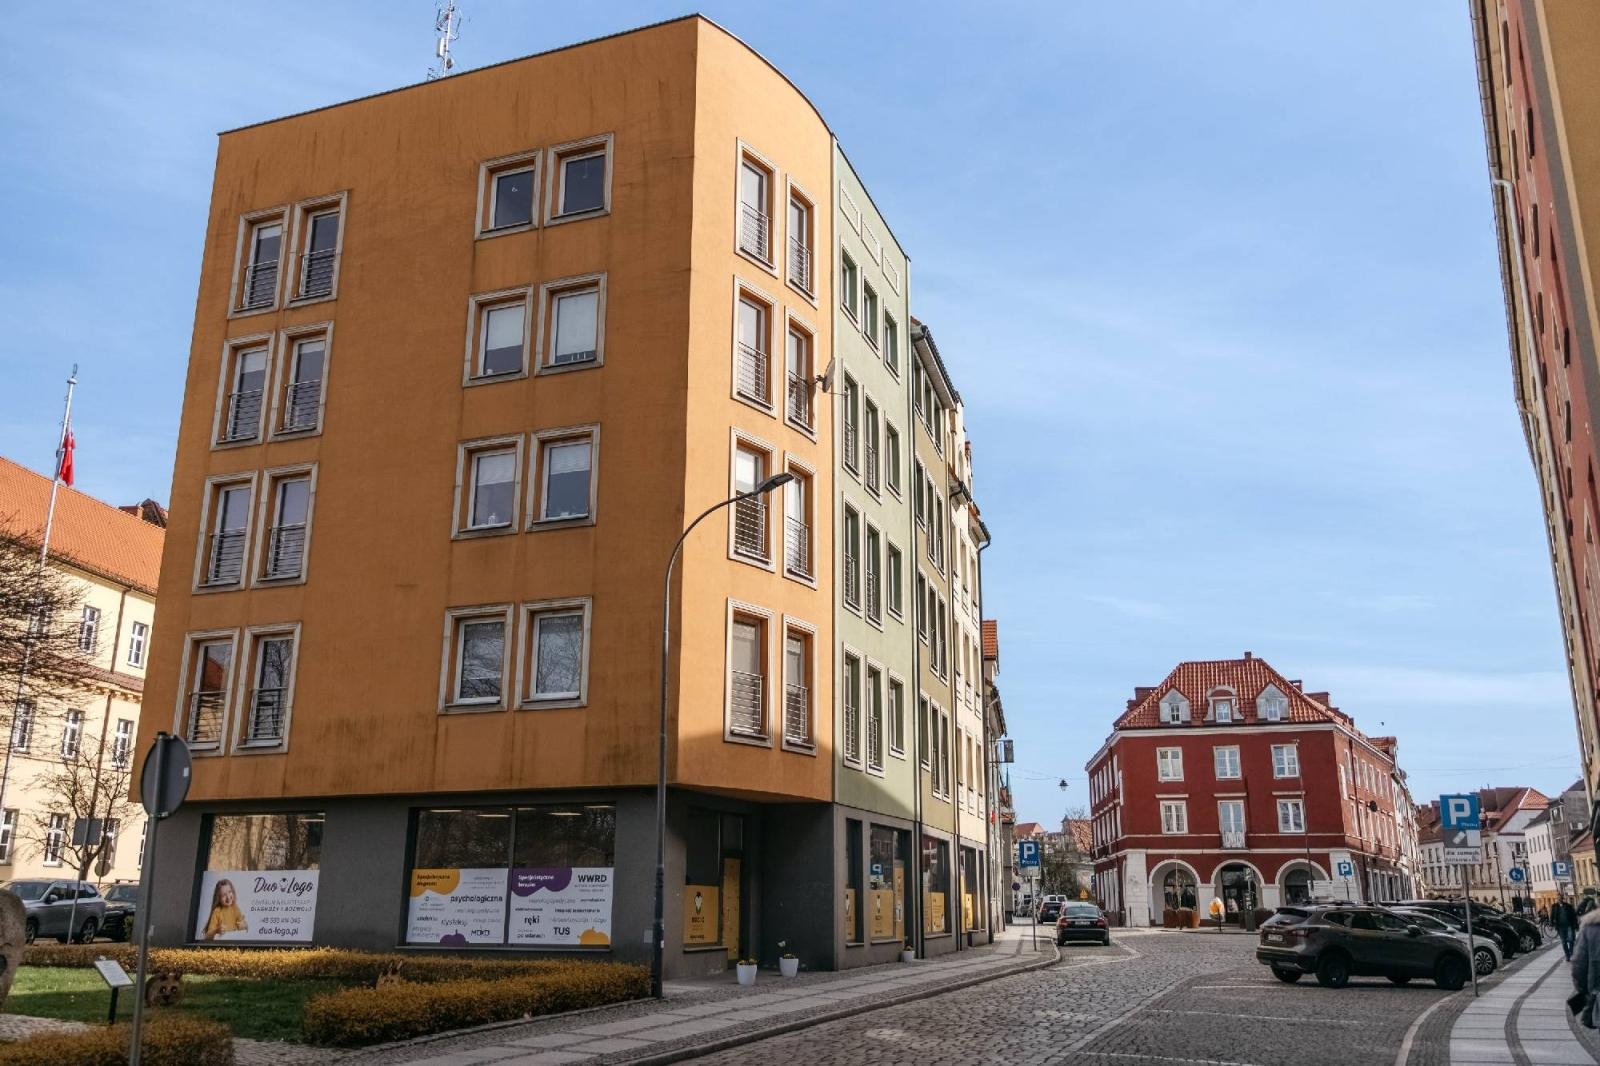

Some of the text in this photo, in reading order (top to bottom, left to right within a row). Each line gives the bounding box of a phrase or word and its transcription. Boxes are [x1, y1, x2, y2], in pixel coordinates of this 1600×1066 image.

[1448, 798, 1471, 825] P
[1023, 843, 1036, 859] P
[1340, 863, 1350, 875] P
[1556, 862, 1567, 875] P
[578, 874, 607, 883] WWRD
[254, 877, 313, 896] Duo Logo
[524, 916, 540, 925] ręki
[258, 926, 298, 936] duo-logo.pl
[553, 927, 570, 935] TUS
